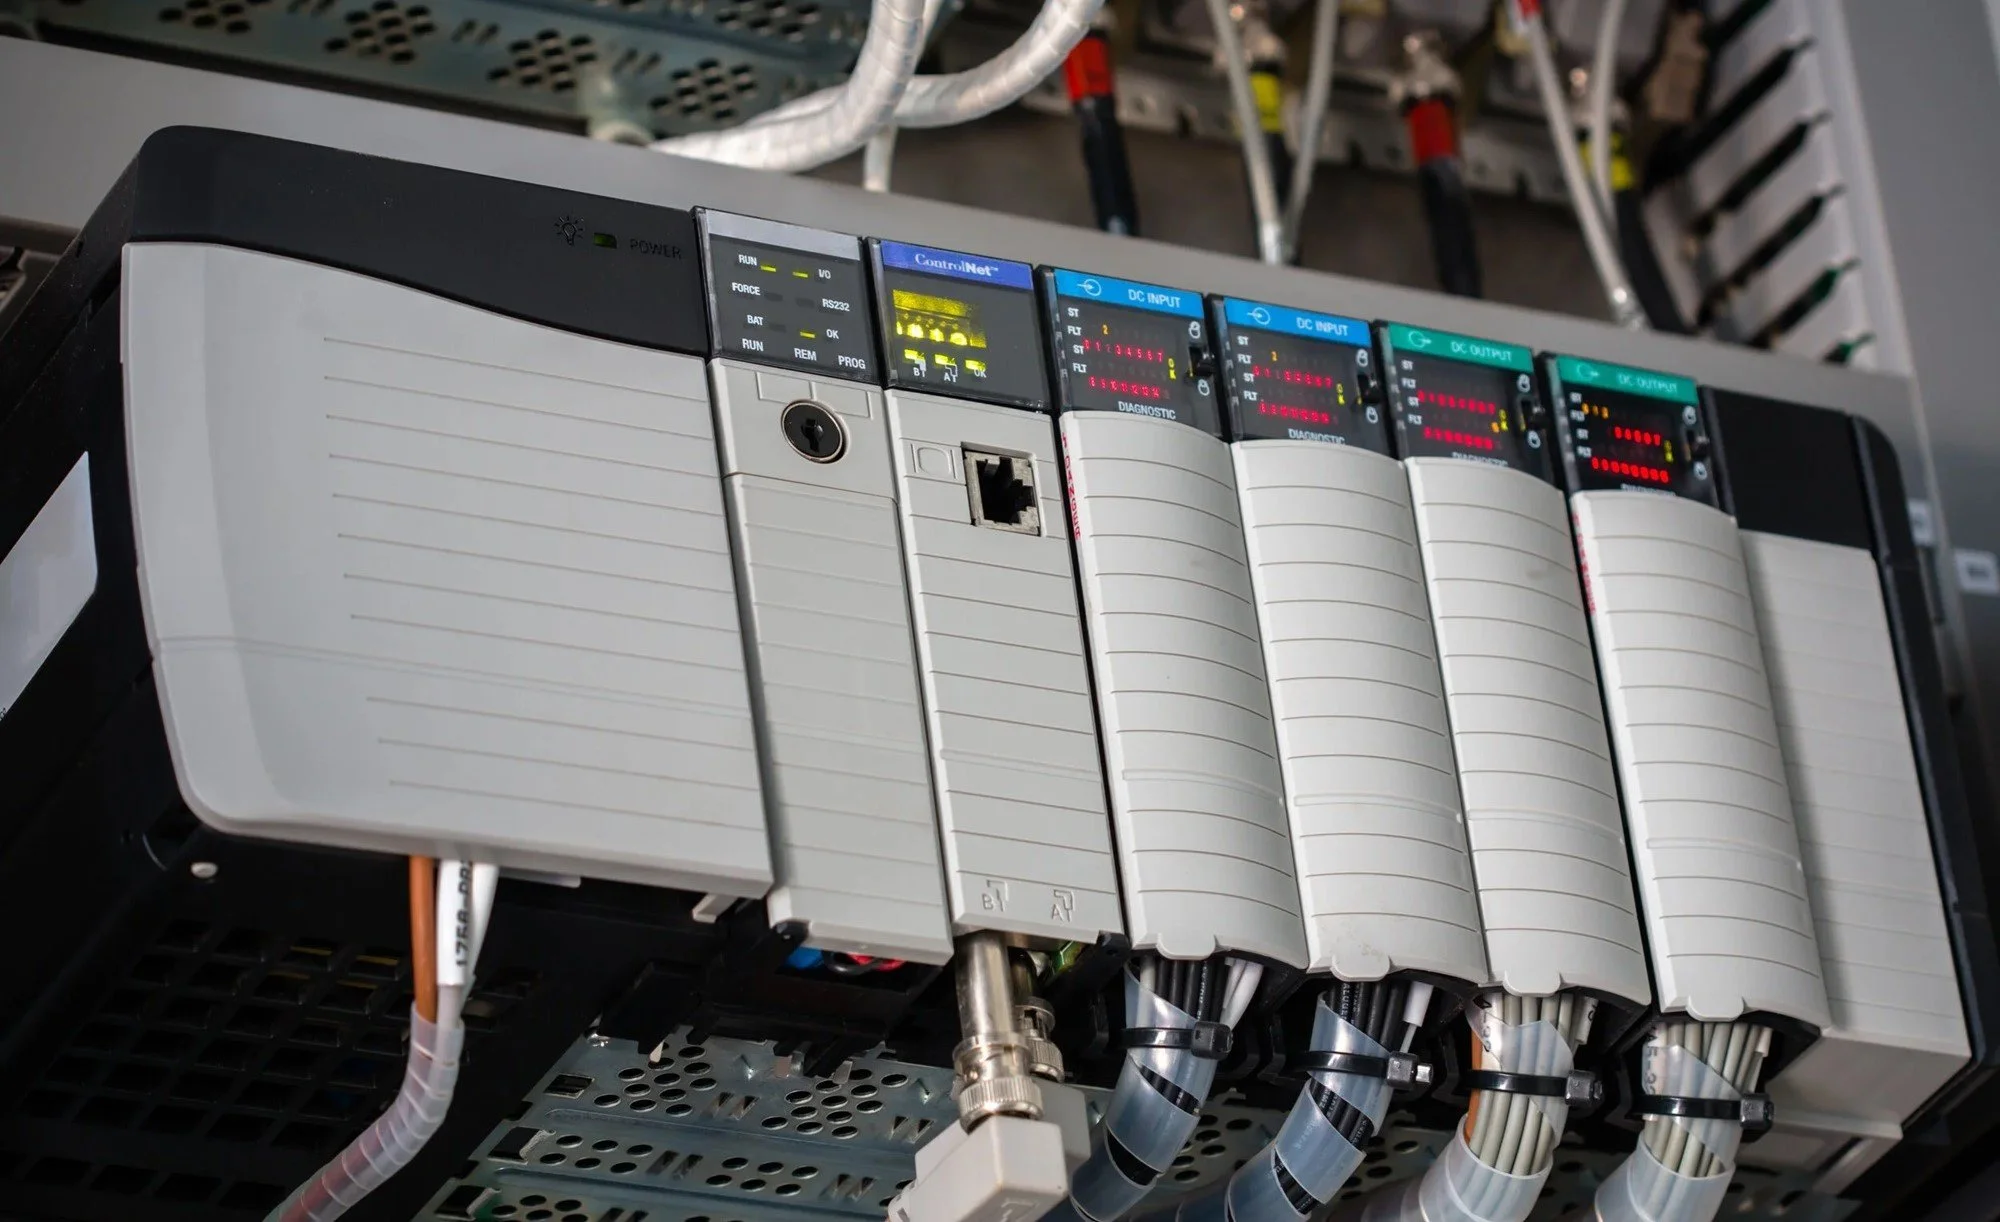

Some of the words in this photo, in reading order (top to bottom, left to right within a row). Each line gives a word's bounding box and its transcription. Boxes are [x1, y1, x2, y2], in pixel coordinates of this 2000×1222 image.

[630, 238, 681, 259] POWER
[738, 254, 757, 266] RUN
[818, 268, 831, 279] I/O
[732, 282, 761, 296] FORCE
[1128, 288, 1145, 302] DC
[1147, 293, 1181, 308] INPUT
[822, 298, 850, 311] RS232
[1068, 307, 1079, 317] ST
[747, 314, 763, 326] BAT
[1067, 325, 1082, 336] FLT
[1296, 317, 1313, 330] DC
[1315, 322, 1349, 336] INPUT
[826, 329, 839, 339] OK
[1238, 336, 1249, 346] ST
[742, 338, 764, 351] RUN
[794, 347, 817, 361] REM
[838, 355, 866, 370] PROG
[1073, 344, 1084, 355] ST
[1451, 341, 1467, 354] DC
[1470, 344, 1512, 362] OUTPUT
[1237, 353, 1252, 364] FLT
[973, 366, 987, 378] OK
[1072, 362, 1087, 373] FLT
[1243, 373, 1254, 383] ST
[1243, 390, 1258, 401] FLT
[1118, 401, 1177, 420] DIAGNOSTIC
[1288, 428, 1346, 445] DIAGNOSTIC
[1063, 455, 1081, 540] DANGER
[982, 893, 994, 911] B
[1051, 903, 1064, 922] A
